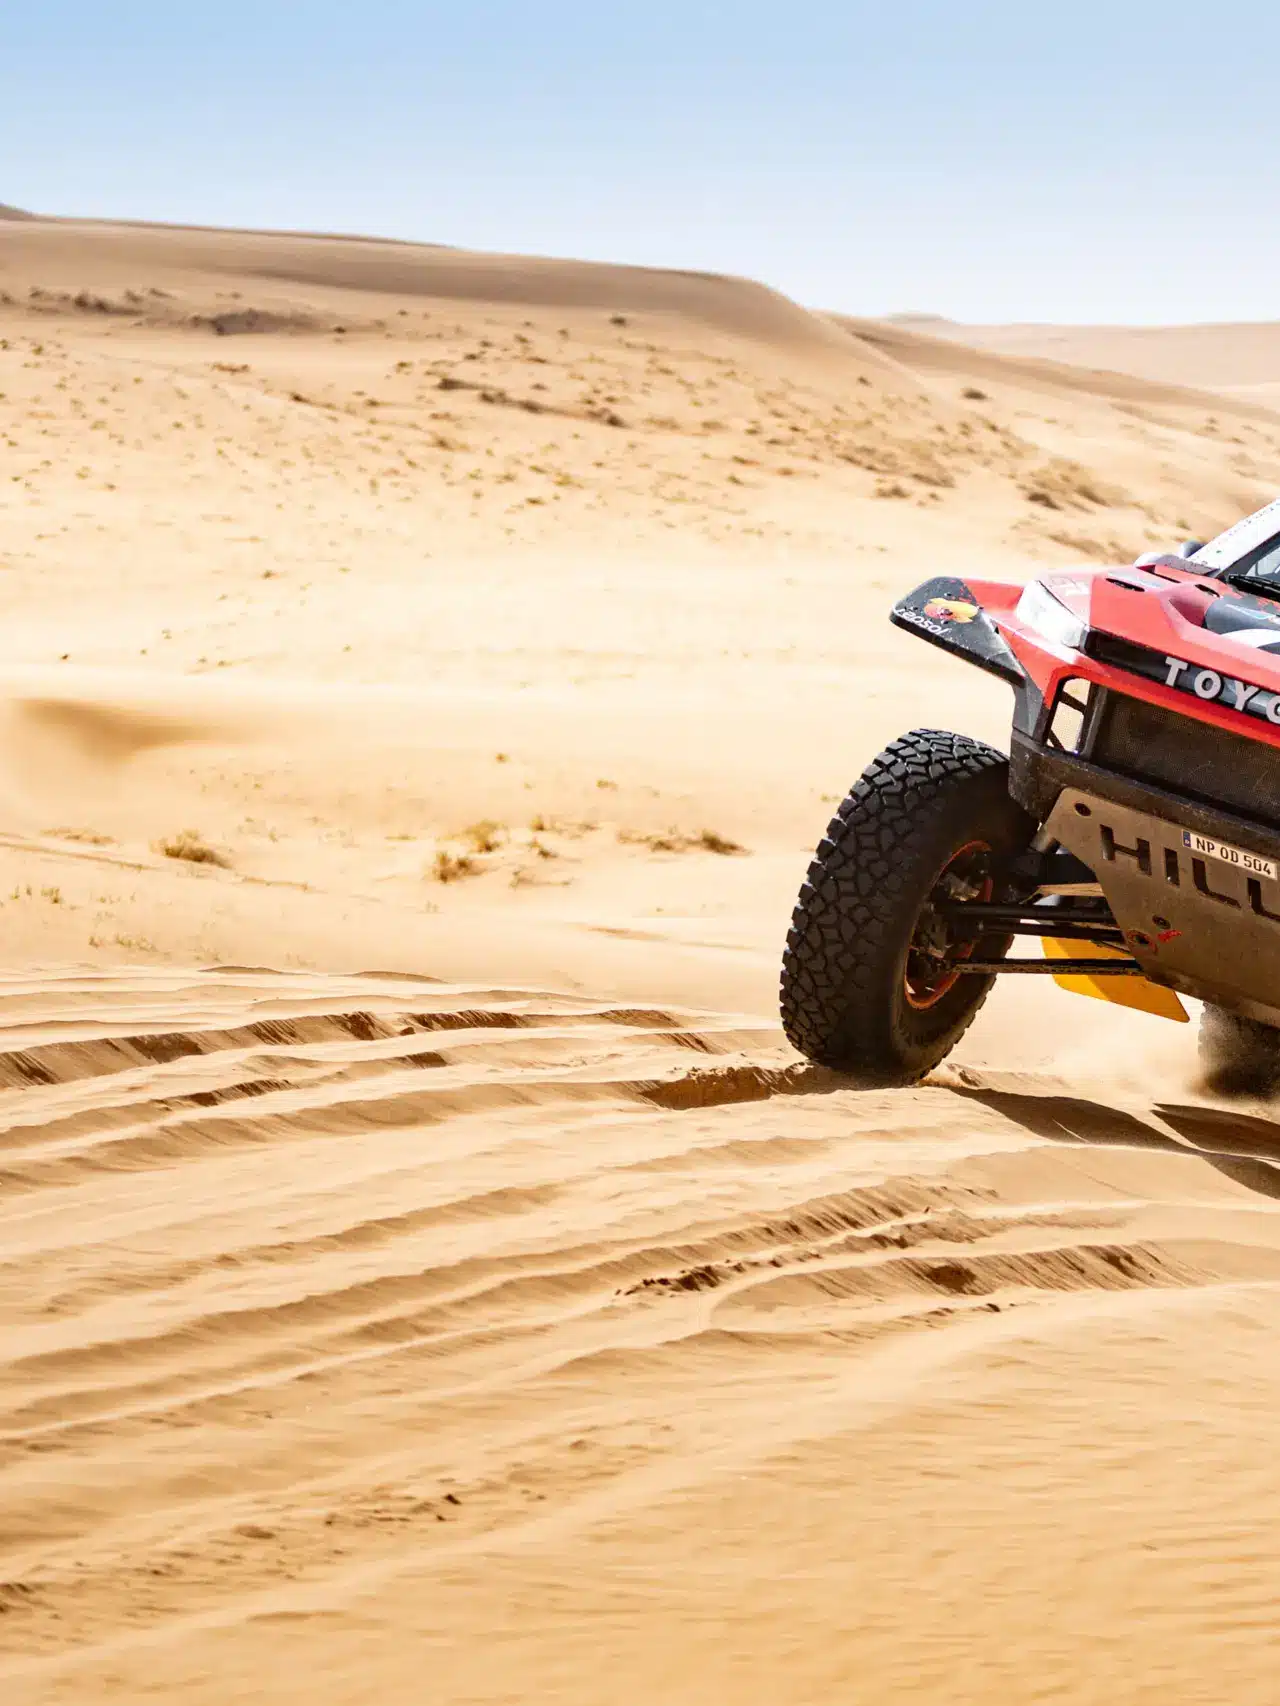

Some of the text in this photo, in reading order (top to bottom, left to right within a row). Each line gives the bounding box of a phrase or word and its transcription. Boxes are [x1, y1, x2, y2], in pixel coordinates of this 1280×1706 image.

[892, 605, 951, 635] repsol
[1196, 837, 1215, 853] NP
[1243, 854, 1272, 875] 504
